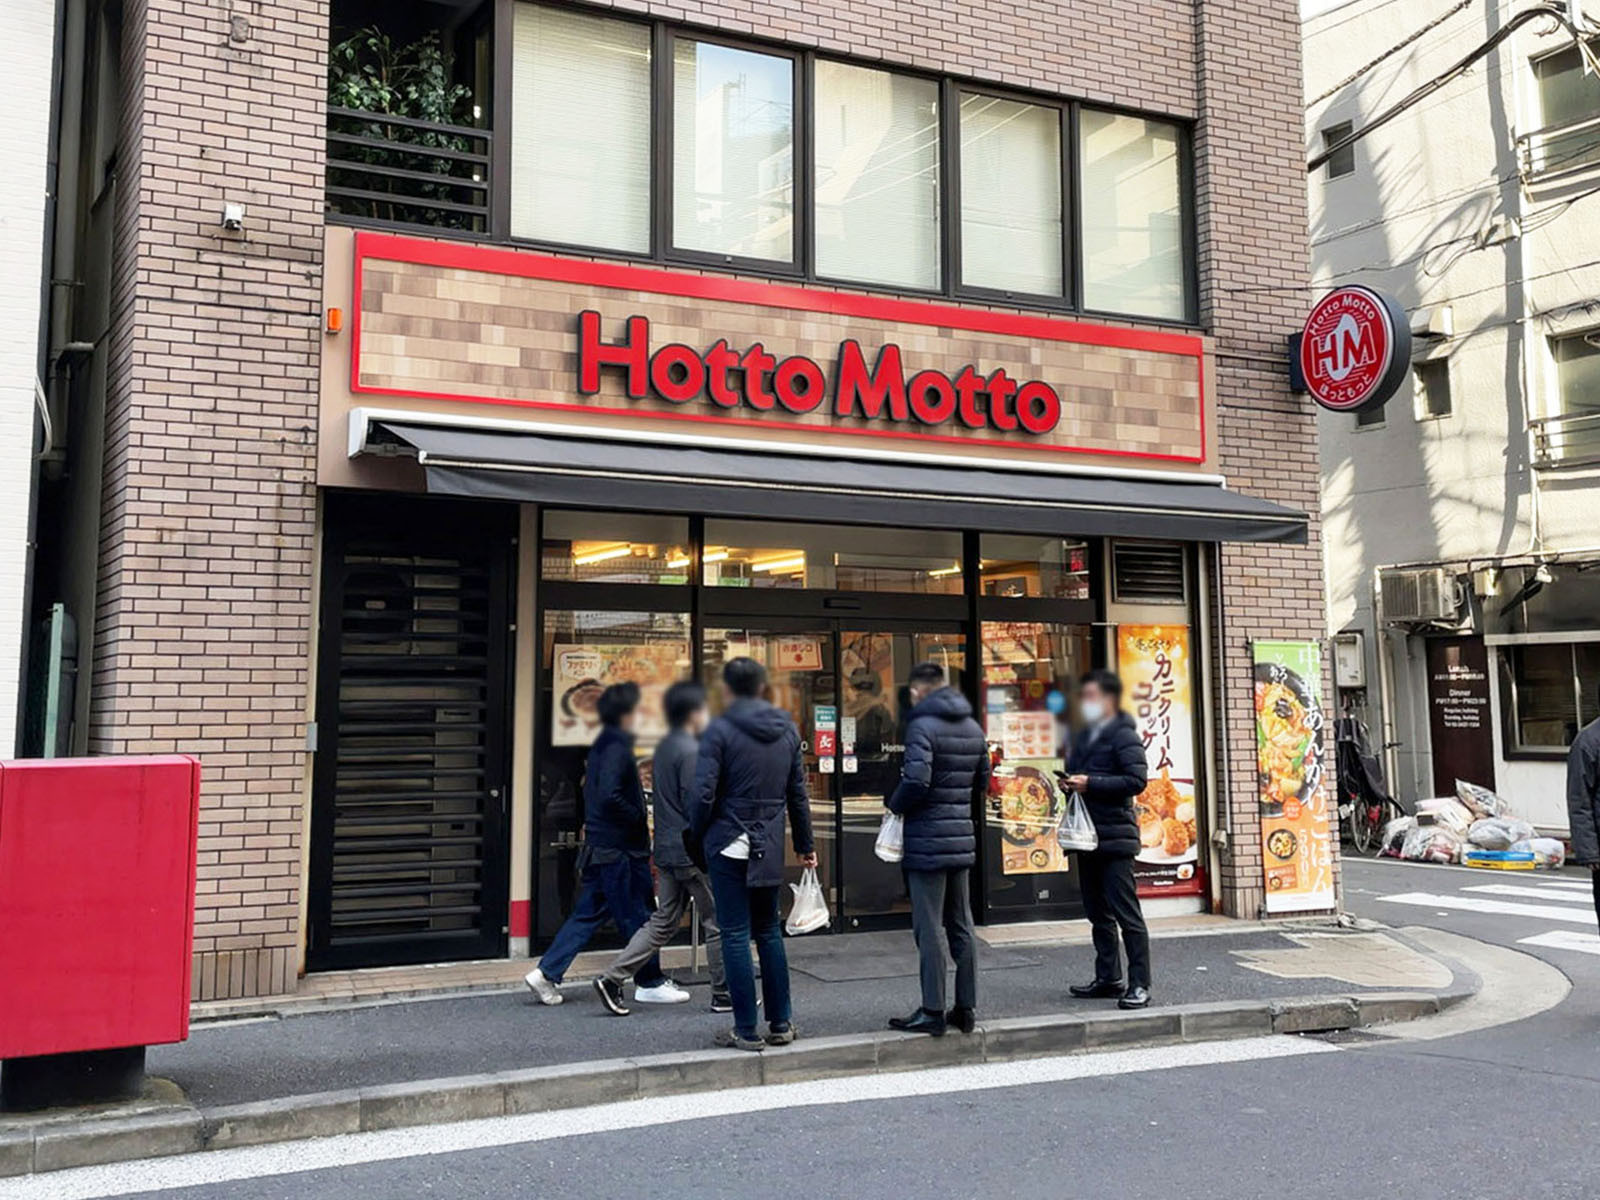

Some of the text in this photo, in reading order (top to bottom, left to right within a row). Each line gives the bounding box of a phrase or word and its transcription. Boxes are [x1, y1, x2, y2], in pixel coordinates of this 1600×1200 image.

[1309, 295, 1375, 335] Hotto Motto
[577, 310, 1061, 434] Hotto Motto
[1311, 322, 1377, 378] HM
[1319, 373, 1373, 400] ほっともっと
[1132, 682, 1160, 751] コロッケ
[1152, 653, 1175, 770] カニクリーム
